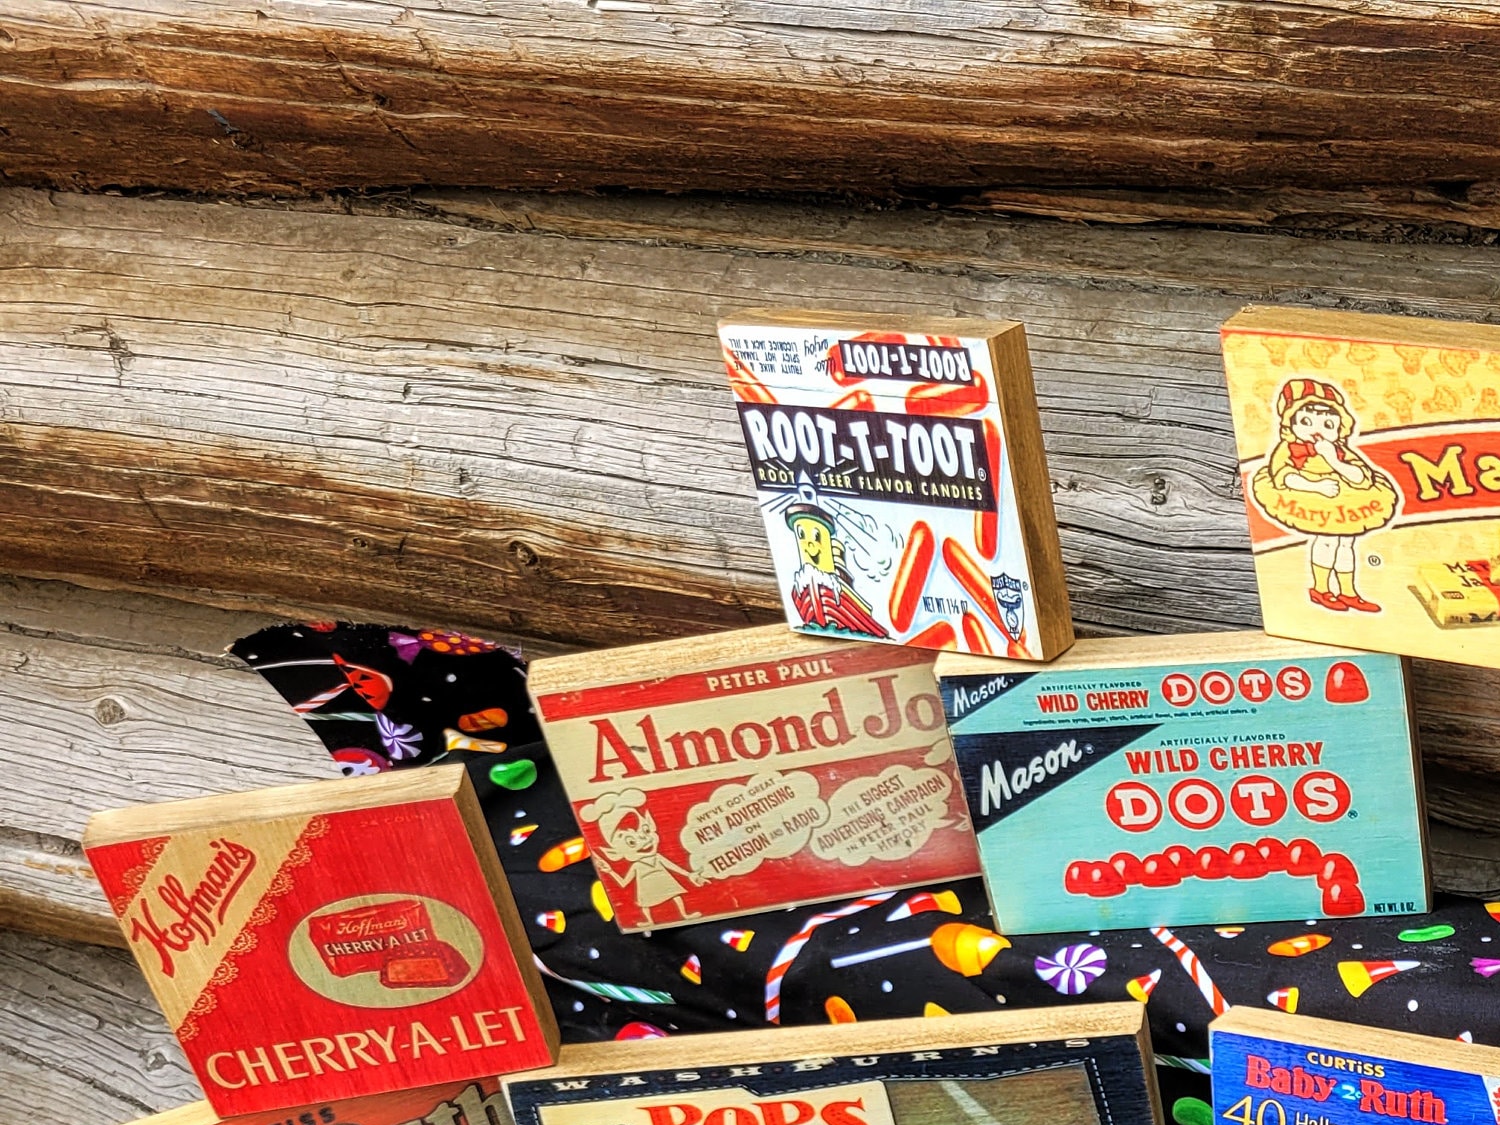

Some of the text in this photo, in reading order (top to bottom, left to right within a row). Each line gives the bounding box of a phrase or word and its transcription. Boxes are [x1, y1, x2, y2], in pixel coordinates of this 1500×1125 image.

[842, 342, 973, 383] ROOT-T-TOOT
[743, 408, 977, 479] ROOT-T-TOOT
[758, 468, 984, 501] ROOT BEER FLAVOR CANDIES
[1274, 494, 1384, 525] Mary Jane
[706, 658, 833, 692] PETER PAUL
[1041, 681, 1142, 692] ARTIFICIALLY FLAVORED
[1164, 667, 1309, 705] DOTS
[953, 675, 1010, 717] Mason
[1036, 690, 1150, 714] WILD CHERRY
[588, 674, 946, 784] Almond Jo
[1159, 733, 1287, 748] ARTIFICIALLY FLAVORED
[979, 739, 1084, 818] Mason
[1125, 741, 1324, 775] WILD CHERRY
[726, 793, 746, 808] GOT
[749, 778, 776, 797] GREAT
[861, 775, 905, 807] BIGGEST
[1109, 774, 1347, 830] DOTS
[694, 785, 796, 845] NEW ADVERTISING
[745, 823, 762, 835] ON
[817, 776, 947, 852] ADVERTISING CAMPAIGN
[901, 804, 934, 826] PAUL
[708, 807, 820, 874] TELEVISION RADIO
[129, 837, 258, 978] Hoffman's
[205, 1006, 526, 1090] CHERRY-A-LET
[552, 1037, 1091, 1092] WASHBURN'S
[1245, 1054, 1338, 1102] Baby
